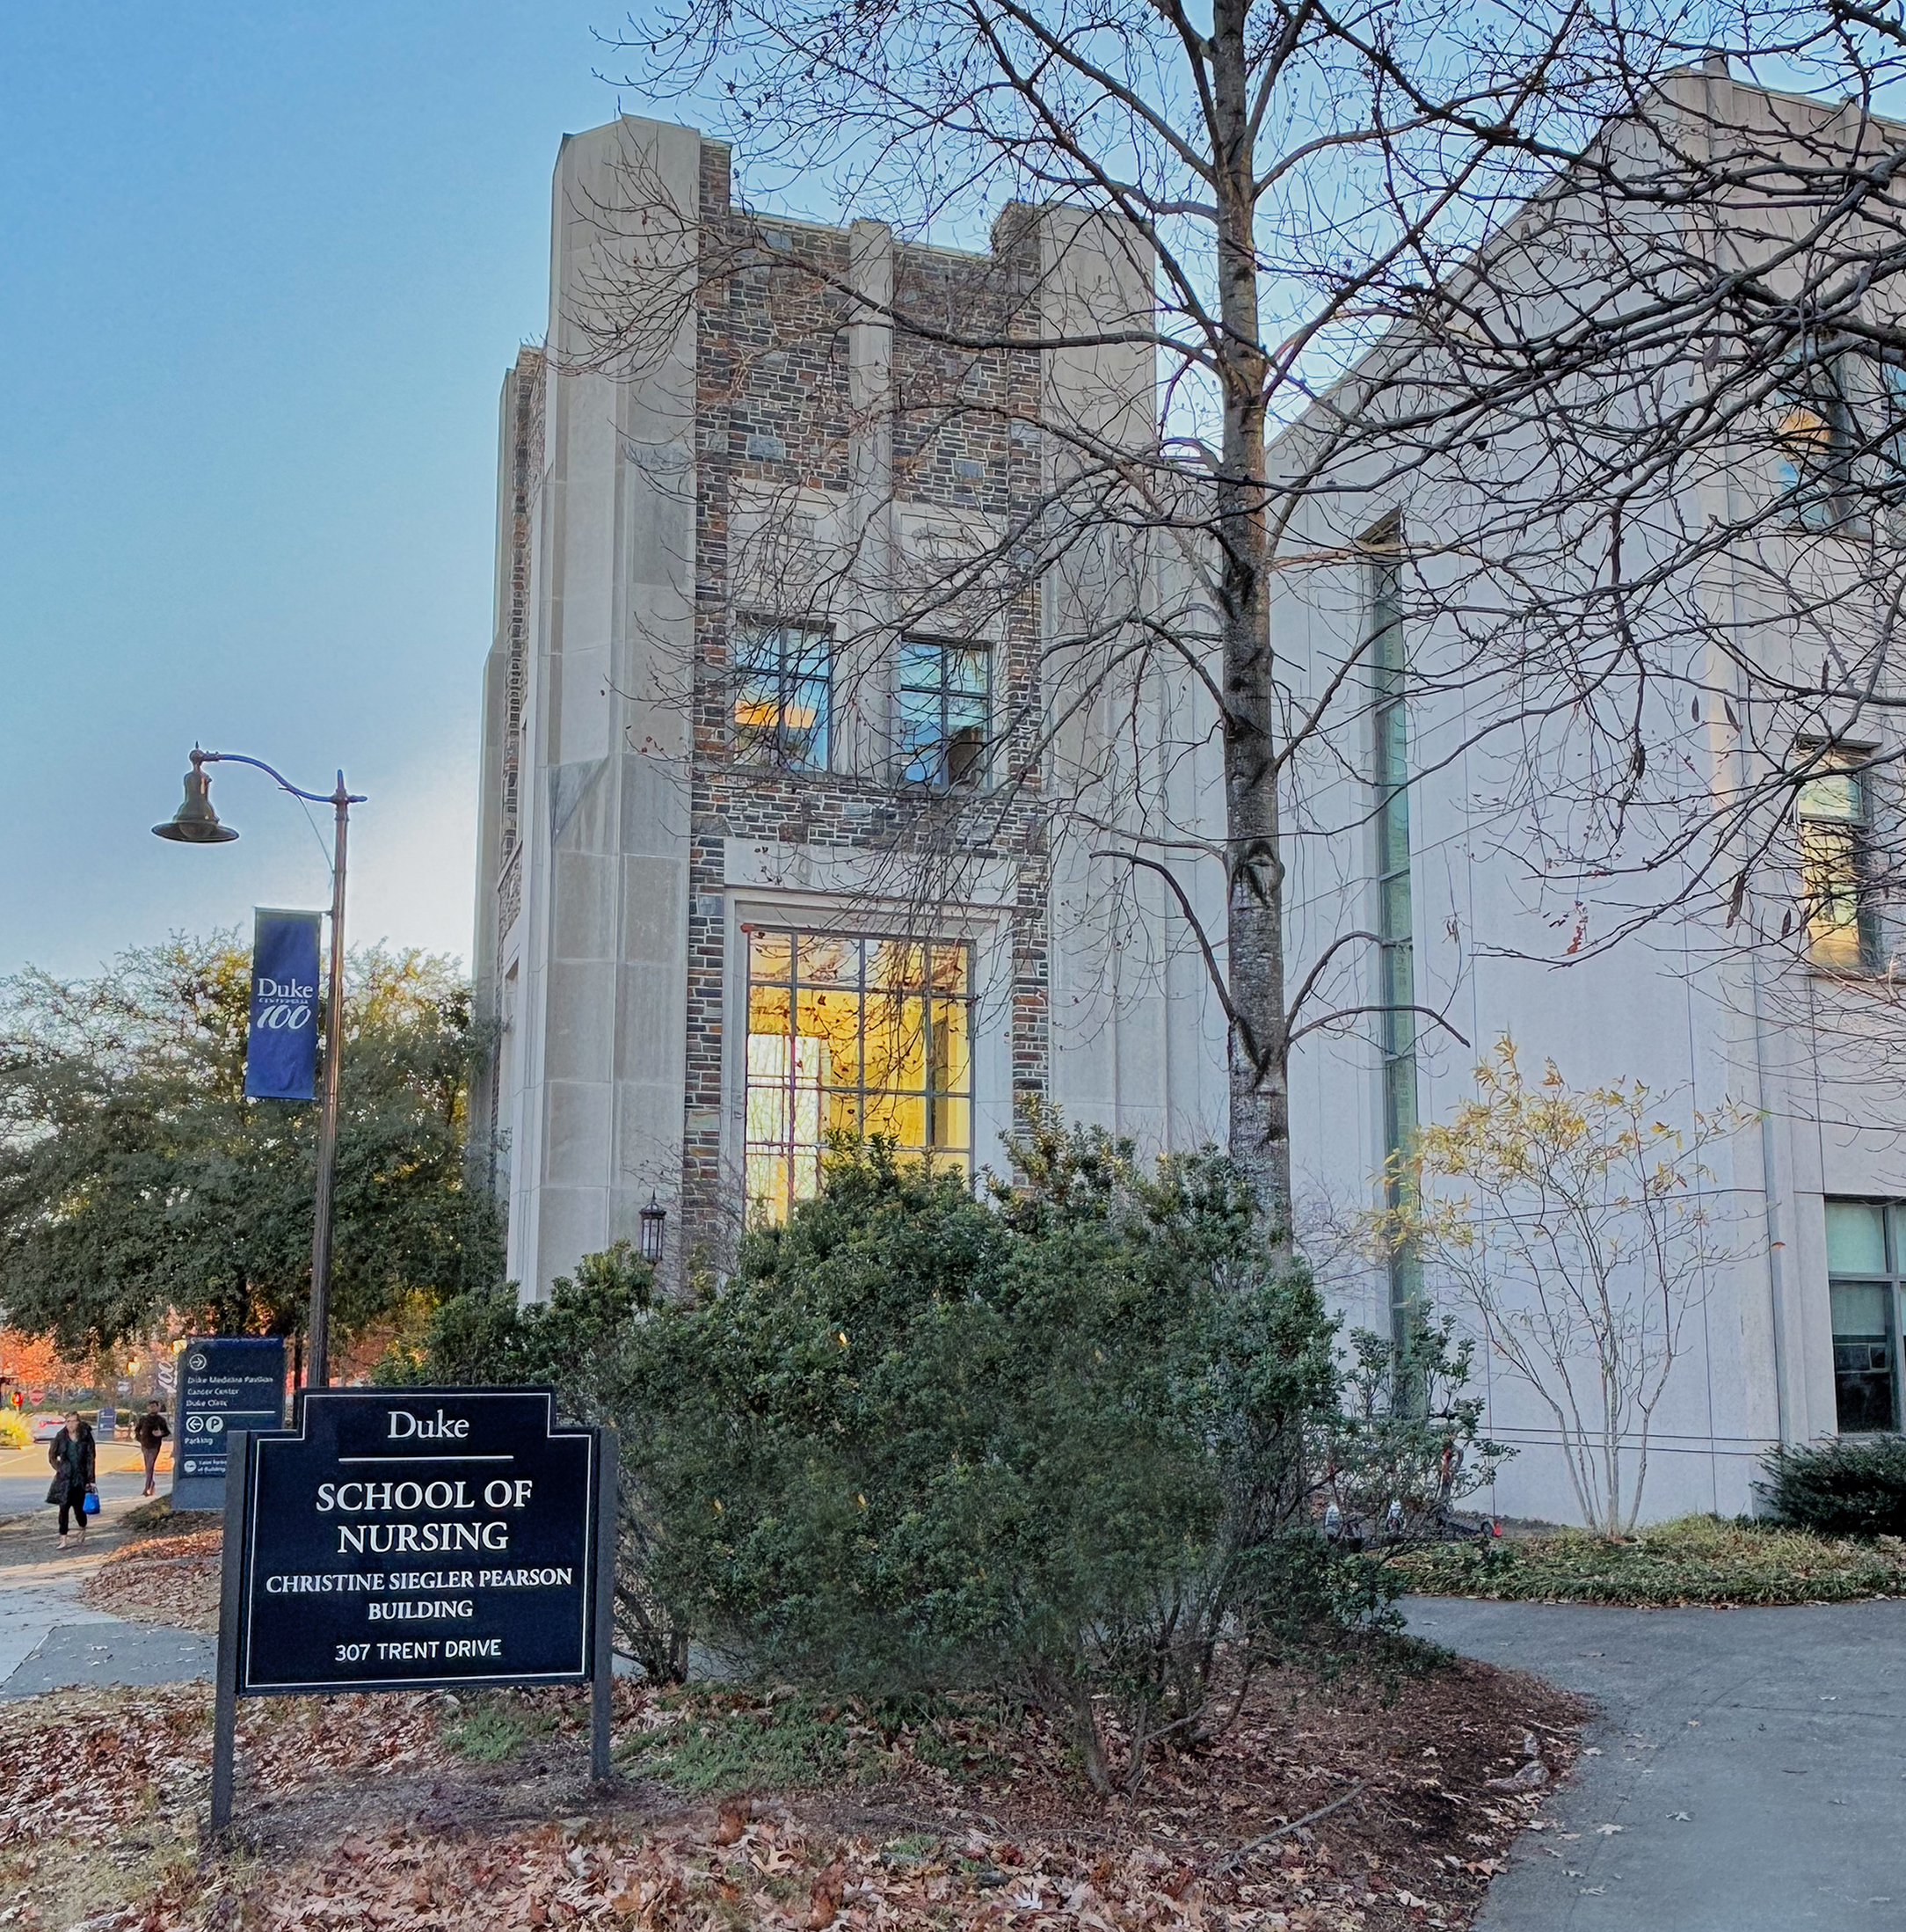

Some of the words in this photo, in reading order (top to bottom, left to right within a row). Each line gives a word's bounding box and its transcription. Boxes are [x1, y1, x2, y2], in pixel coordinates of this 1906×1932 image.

[257, 978, 313, 998] Duke
[257, 1004, 311, 1029] 100
[387, 1409, 469, 1440] Duke
[184, 1437, 214, 1446] Parking
[316, 1481, 475, 1511] SCHOOL
[484, 1480, 533, 1507] OF
[337, 1522, 508, 1553] NURSING
[266, 1574, 384, 1593] CHRISTINE
[389, 1571, 474, 1589] SIEGLER
[479, 1568, 571, 1587] PEARSON
[367, 1600, 474, 1621] BUILDING
[335, 1643, 371, 1662] 307
[376, 1641, 440, 1659] TRENT
[445, 1639, 502, 1658] DRIVE
